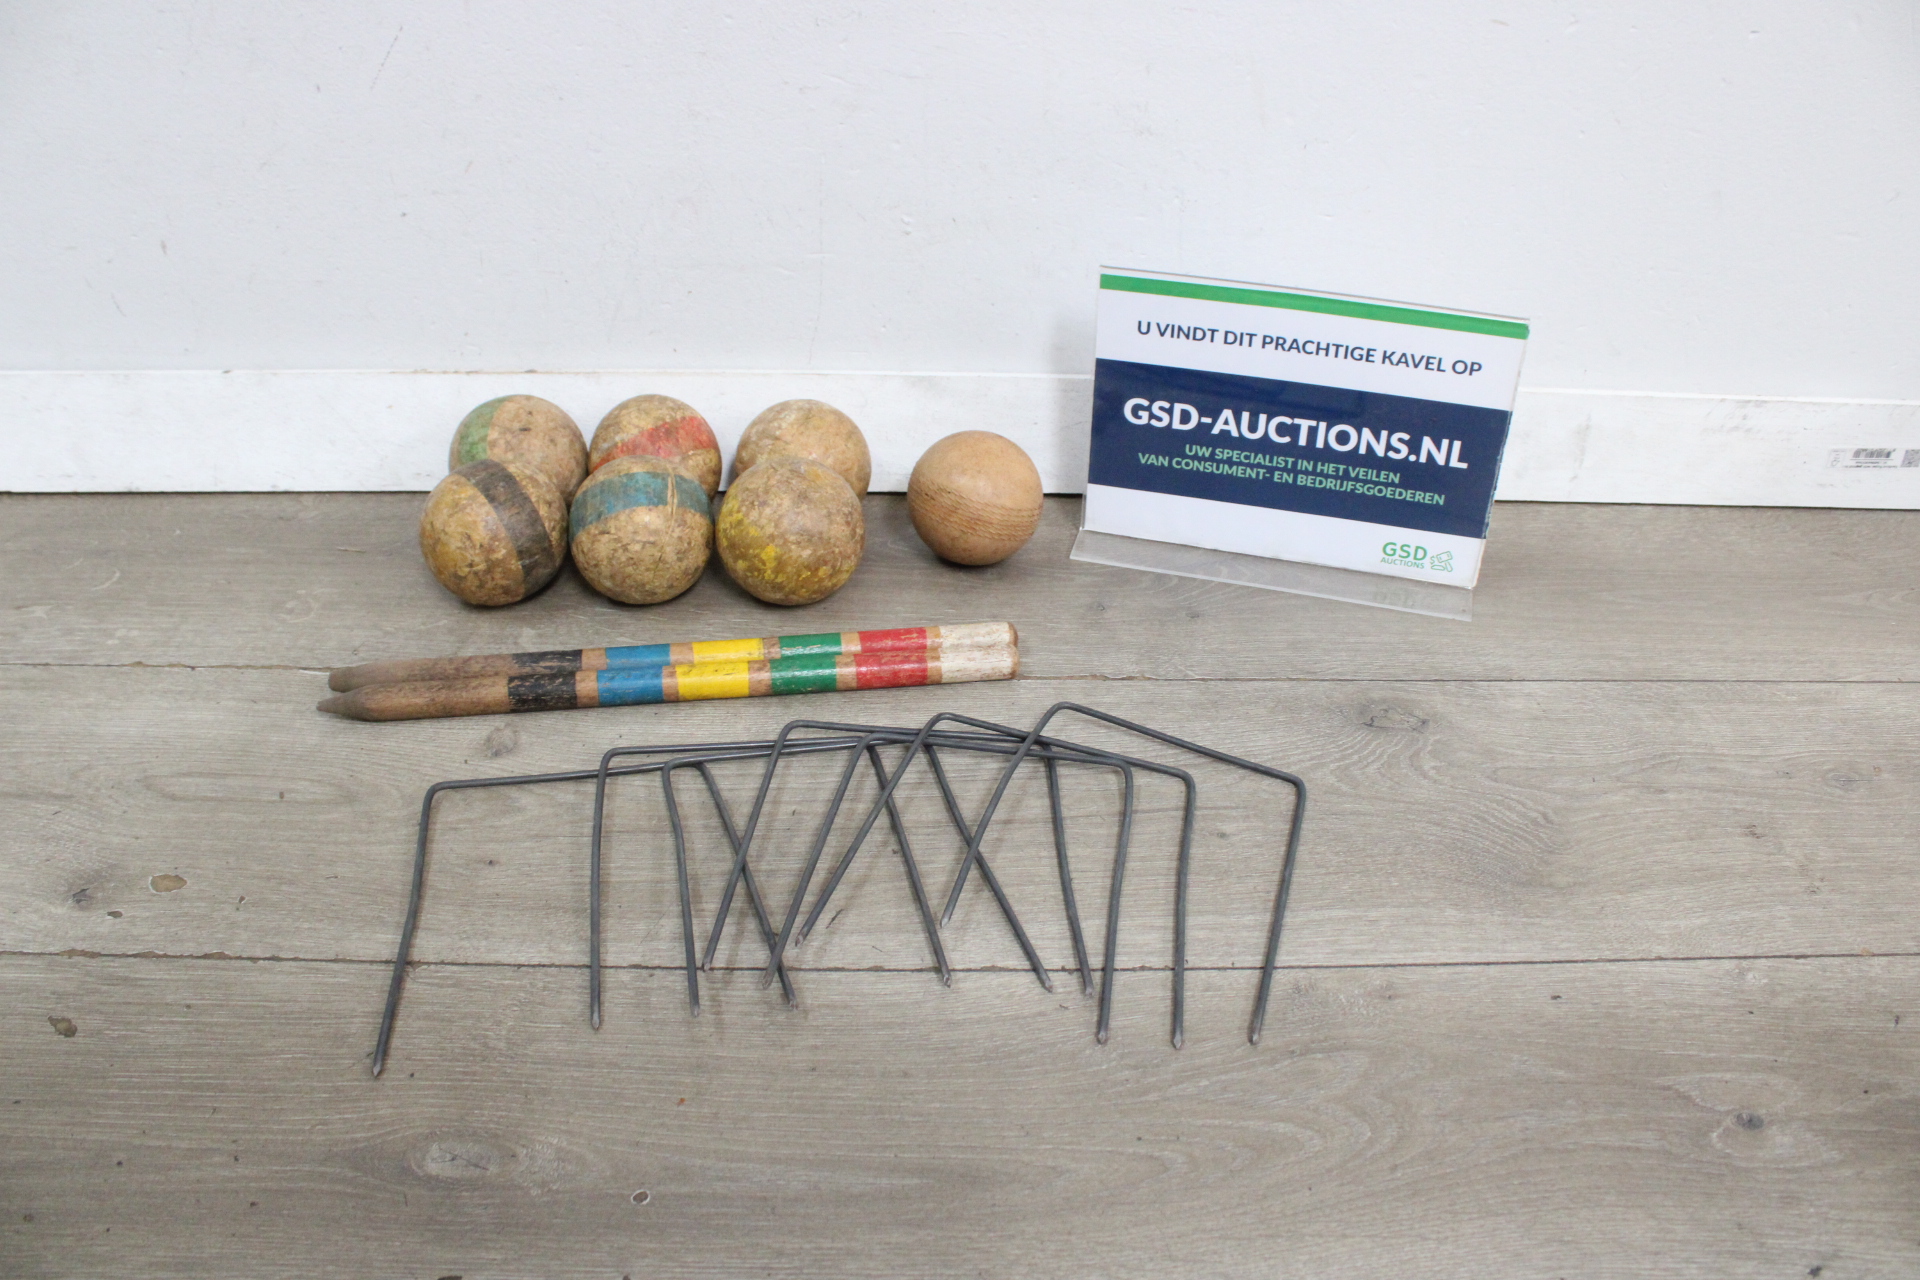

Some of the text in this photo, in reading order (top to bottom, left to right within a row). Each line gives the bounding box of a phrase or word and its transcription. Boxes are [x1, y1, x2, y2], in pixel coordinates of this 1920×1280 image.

[1137, 321, 1482, 376] U VINDT DIT PRACHTIGE KAVEL OP
[1123, 398, 1468, 469] GSD-AUCTIONS.NL
[1139, 453, 1445, 505] VAN CONSUMENT- EN BEDRIJFSGOEDEREN
[1185, 444, 1400, 484] UW SPECIALIST IN HET VEILEN
[1381, 557, 1425, 569] AUCTIONS
[1382, 541, 1428, 561] GSD
